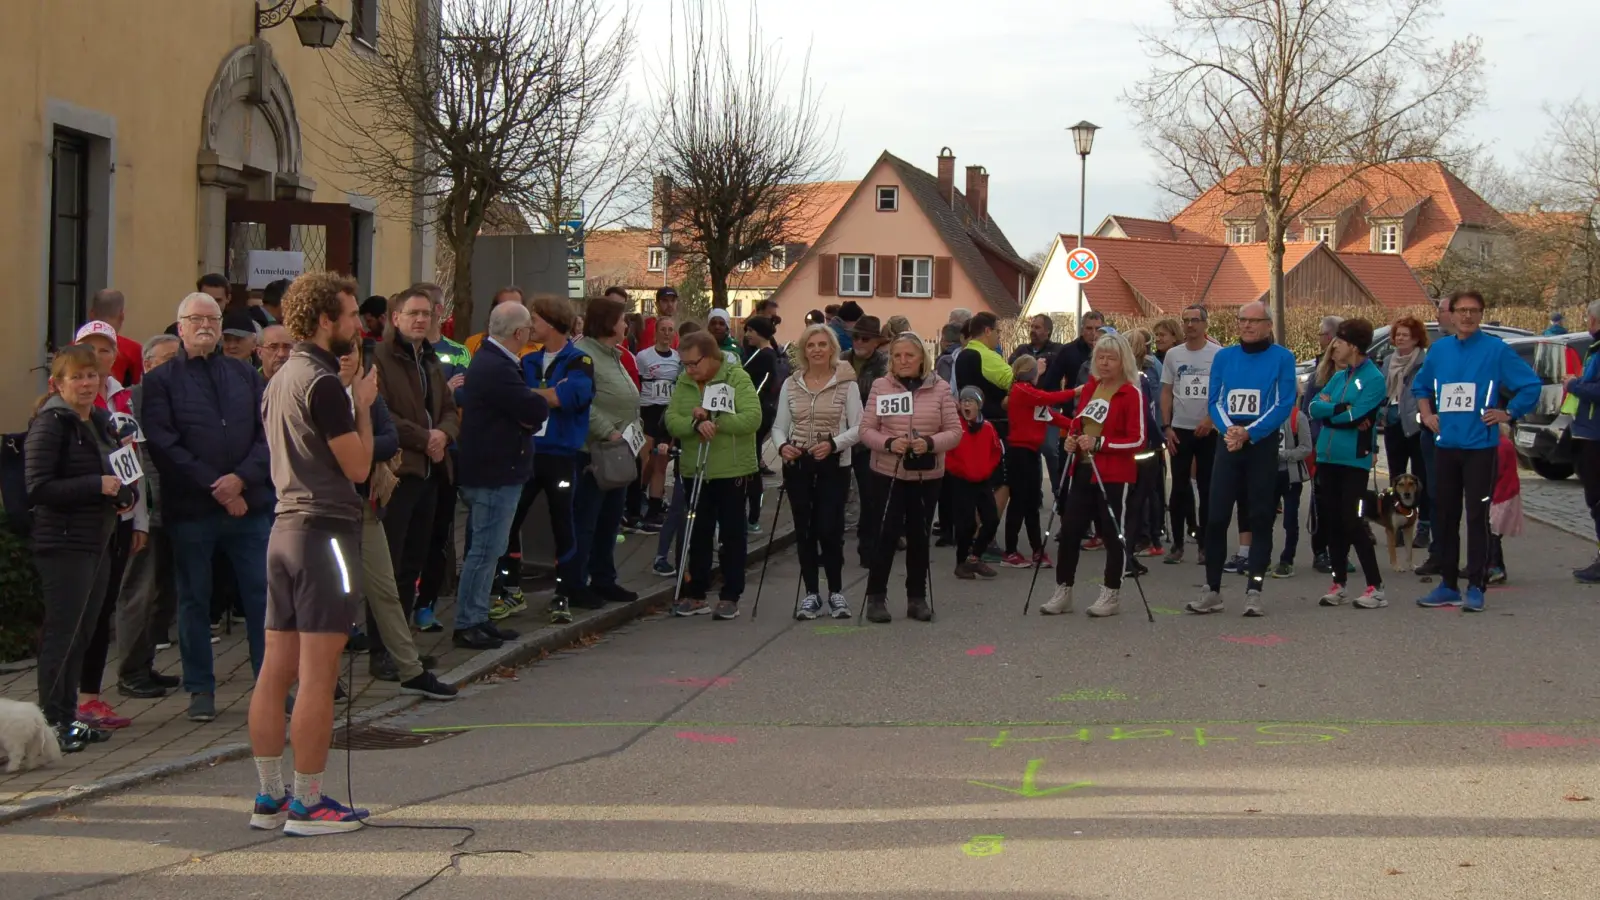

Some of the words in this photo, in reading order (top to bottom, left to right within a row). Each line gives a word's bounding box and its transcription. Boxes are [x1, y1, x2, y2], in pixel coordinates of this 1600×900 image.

[254, 267, 300, 277] Anmeldung
[93, 323, 103, 332] P
[1185, 386, 1207, 396] 834
[711, 396, 733, 410] 644
[881, 396, 910, 414] 350
[1230, 394, 1257, 413] 378
[1447, 396, 1472, 408] 742
[114, 450, 138, 481] 181
[963, 723, 1350, 749] Start
